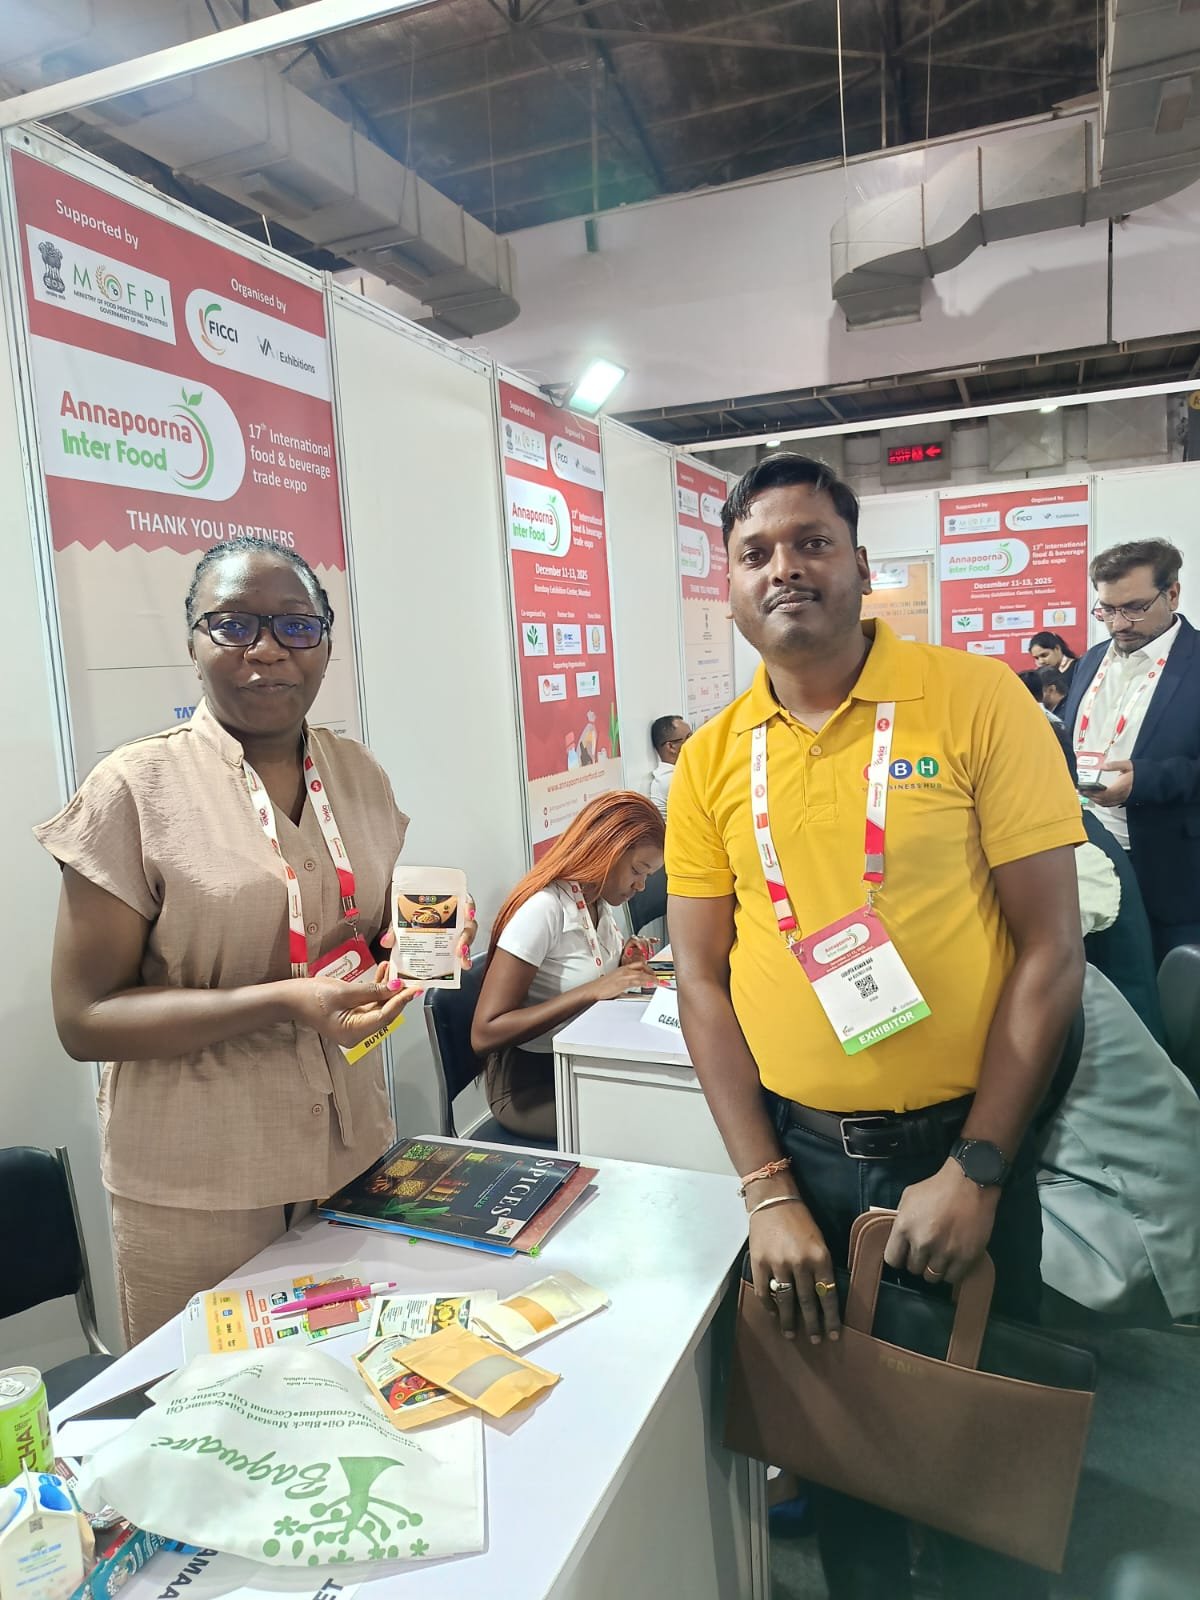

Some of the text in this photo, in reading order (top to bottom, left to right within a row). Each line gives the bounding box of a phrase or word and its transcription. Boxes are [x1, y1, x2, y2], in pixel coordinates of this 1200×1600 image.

[55, 199, 139, 250] Supported by
[231, 278, 287, 315] Organised by
[100, 307, 130, 322] GOVERNMENT
[208, 320, 239, 343] FICCI
[279, 351, 316, 374] Exhibitions
[60, 390, 193, 444] Annapoorna
[62, 428, 167, 471] Inter Food
[270, 428, 331, 458] International
[250, 445, 331, 479] food & beverage
[253, 469, 307, 494] trade expo
[512, 503, 553, 526] Annapoorna
[126, 510, 296, 548] THANK YOU PARTNERS
[512, 522, 545, 542] Inter Food
[1045, 541, 1086, 550] International
[1055, 548, 1084, 558] beverage
[949, 553, 1004, 565] Annapoorna
[535, 563, 561, 578] December
[949, 564, 990, 574] Inter Food
[973, 581, 1009, 590] December
[1034, 577, 1053, 585] 2025
[658, 1014, 681, 1029] CLEAN
[859, 1011, 914, 1044] EXHIBITOR
[364, 1026, 389, 1048] BUYER
[490, 1160, 555, 1217] SPICES
[171, 1397, 187, 1406] Oil
[186, 1399, 225, 1411] Sesame
[233, 1394, 248, 1408] Oil
[166, 1406, 184, 1416] Oil
[229, 1403, 245, 1416] Oil
[250, 1405, 292, 1419] Coconut
[300, 1410, 356, 1419] Groundnut
[247, 1413, 289, 1429] Mustard
[294, 1420, 321, 1429] Black
[328, 1420, 345, 1428] Oil
